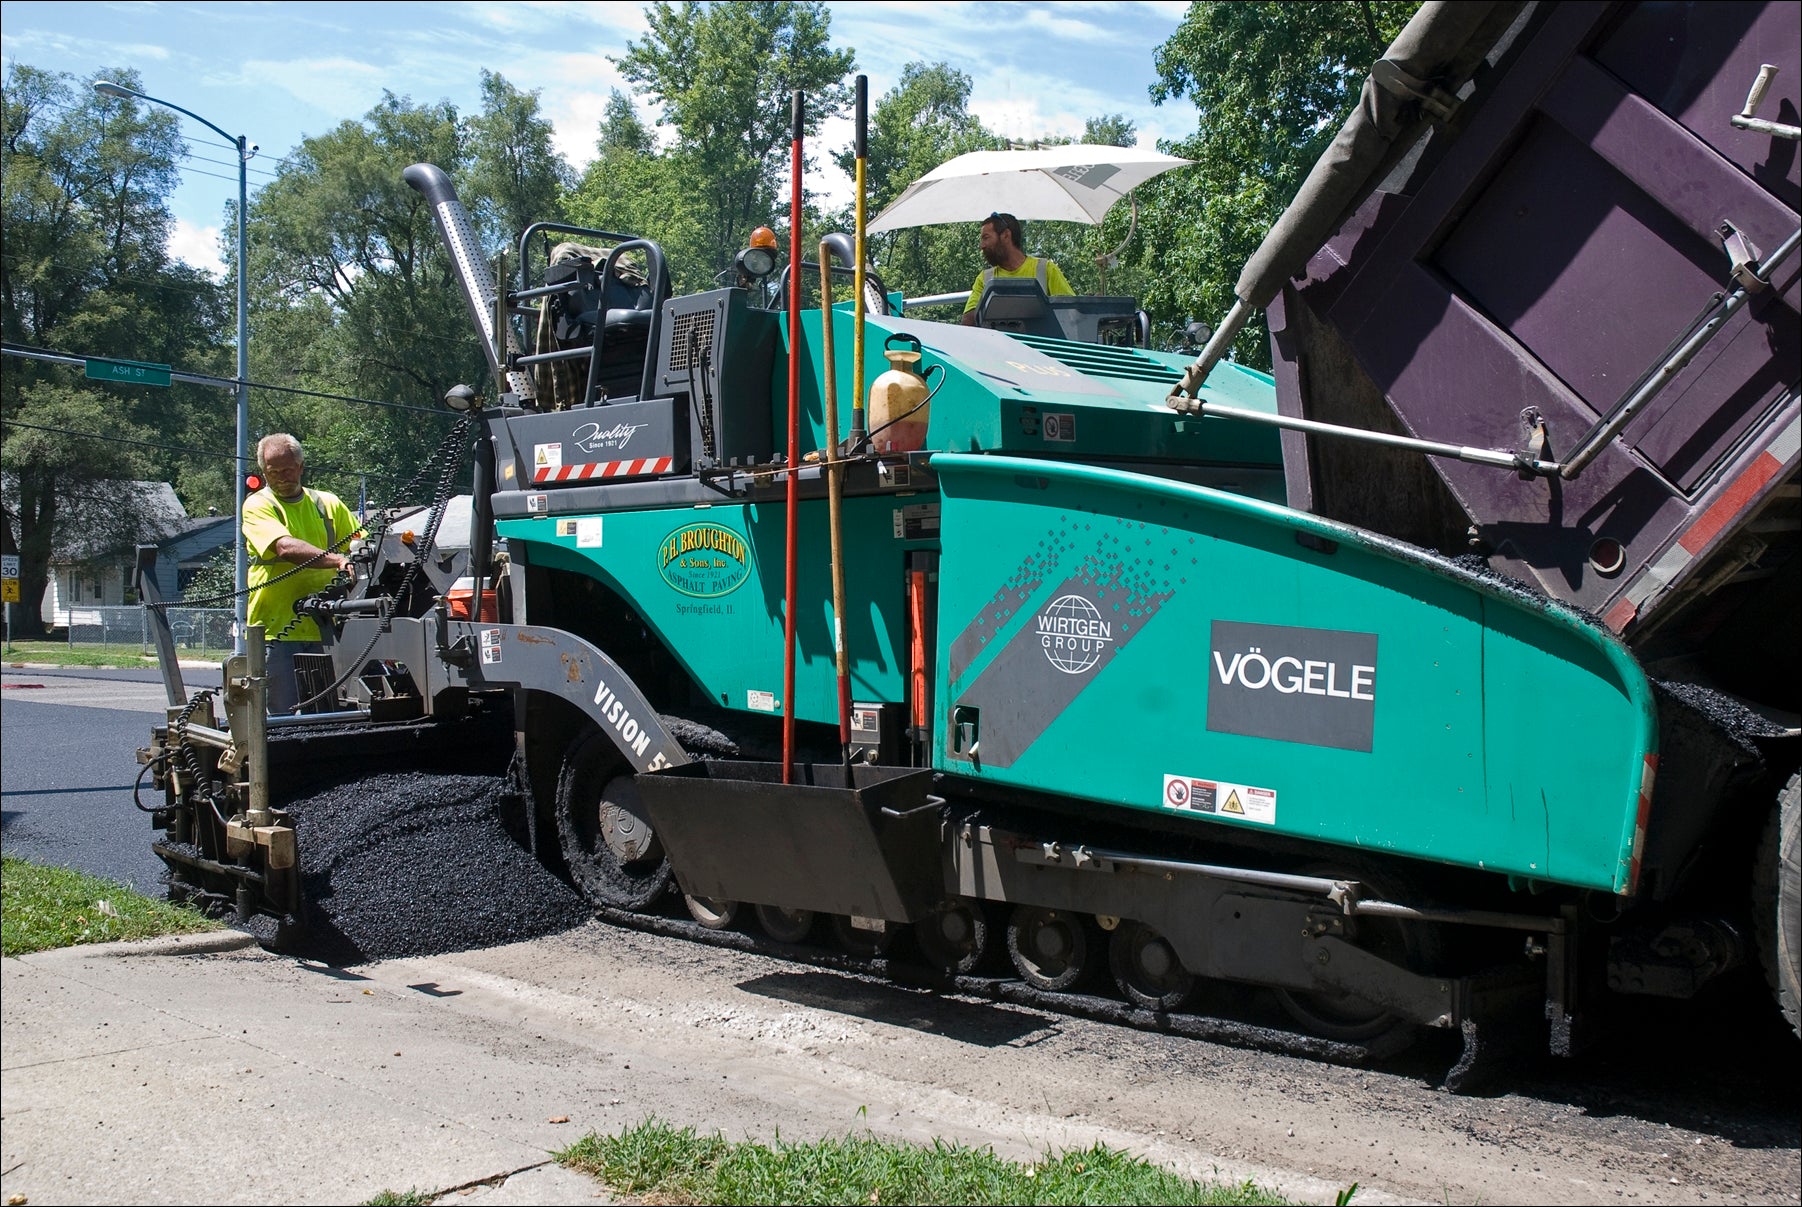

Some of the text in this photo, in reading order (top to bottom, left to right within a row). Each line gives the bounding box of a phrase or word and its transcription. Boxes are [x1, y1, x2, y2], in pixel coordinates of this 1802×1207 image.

[112, 366, 146, 377] ASH ST
[572, 422, 649, 453] Quality
[680, 528, 746, 568] BROUGHTON
[2, 567, 18, 576] 30
[680, 557, 729, 570] & Sons, Inc.
[668, 568, 743, 593] ASPHALT PAVING
[688, 571, 721, 579] Since 1921
[676, 603, 724, 616] Springfield,
[1038, 615, 1110, 638] WIRTGEN
[1041, 635, 1105, 653] GROUP
[1213, 647, 1376, 700] VÖGELE
[593, 680, 651, 757] VISION
